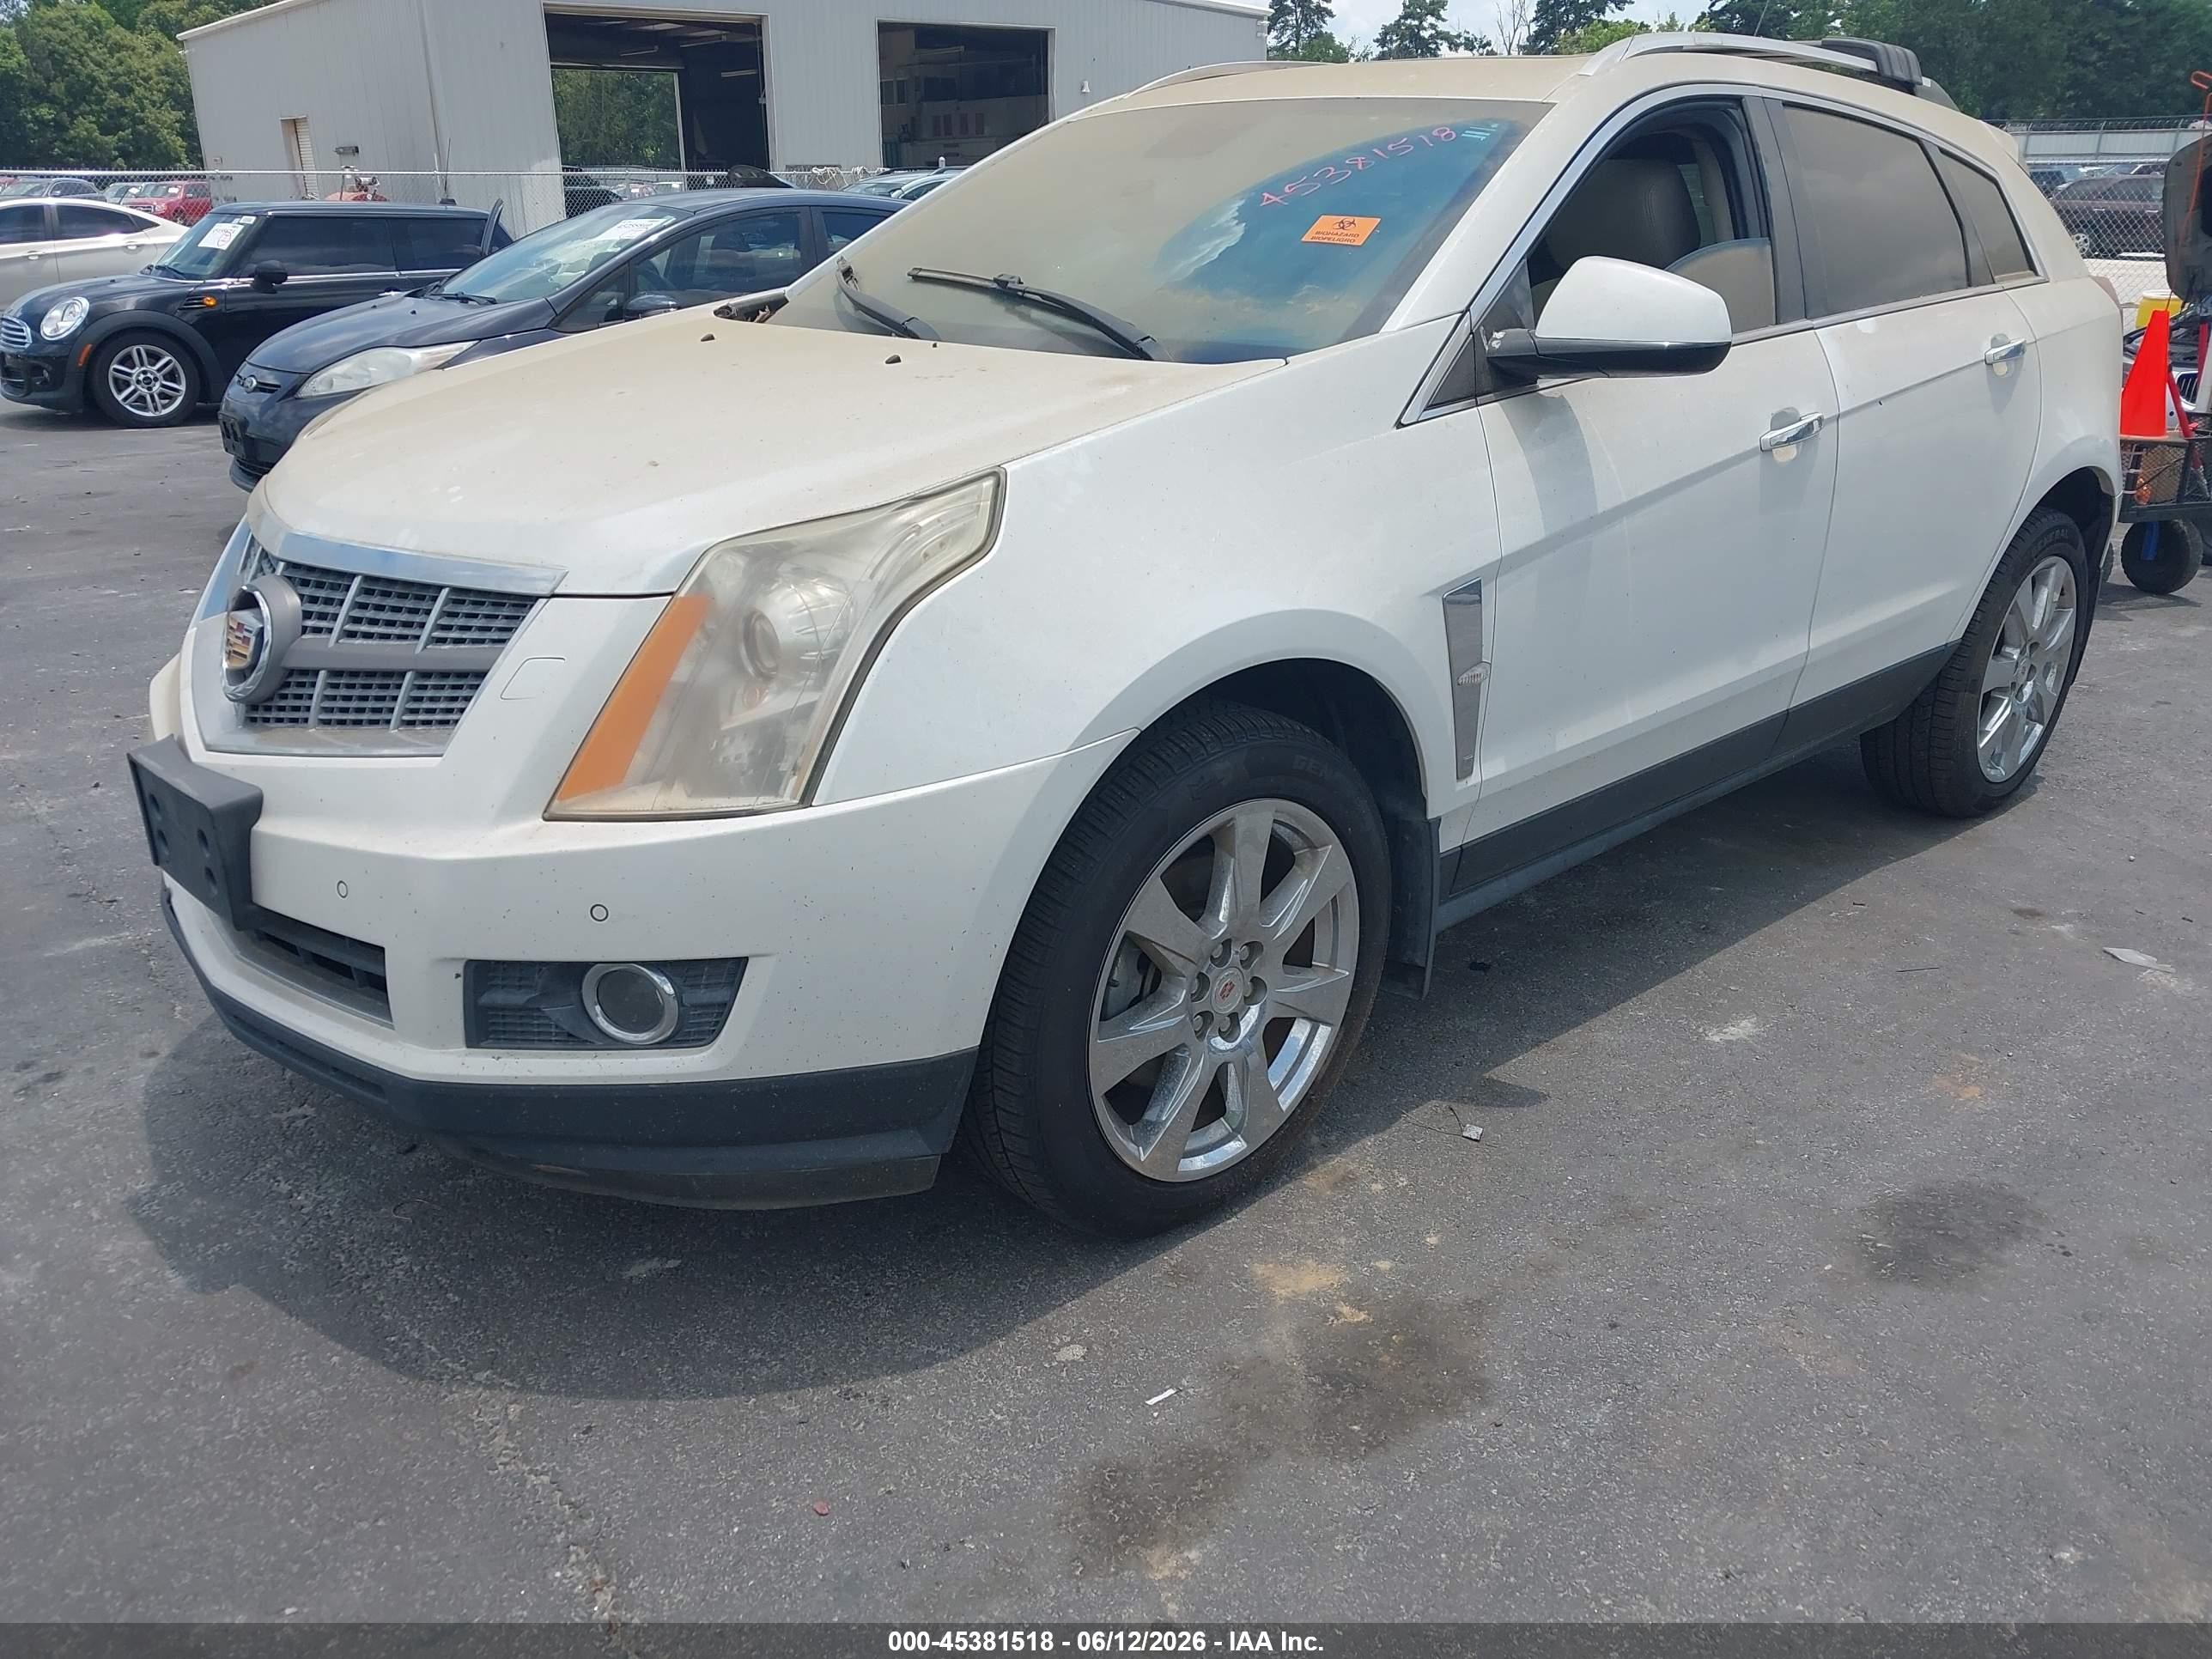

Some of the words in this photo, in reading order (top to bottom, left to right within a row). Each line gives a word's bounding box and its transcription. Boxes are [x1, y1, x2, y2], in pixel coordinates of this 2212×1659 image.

[1260, 126, 1457, 206] 45381518
[1315, 230, 1360, 239] BIOHAZARD
[1310, 235, 1357, 244] BIOPELIGRO
